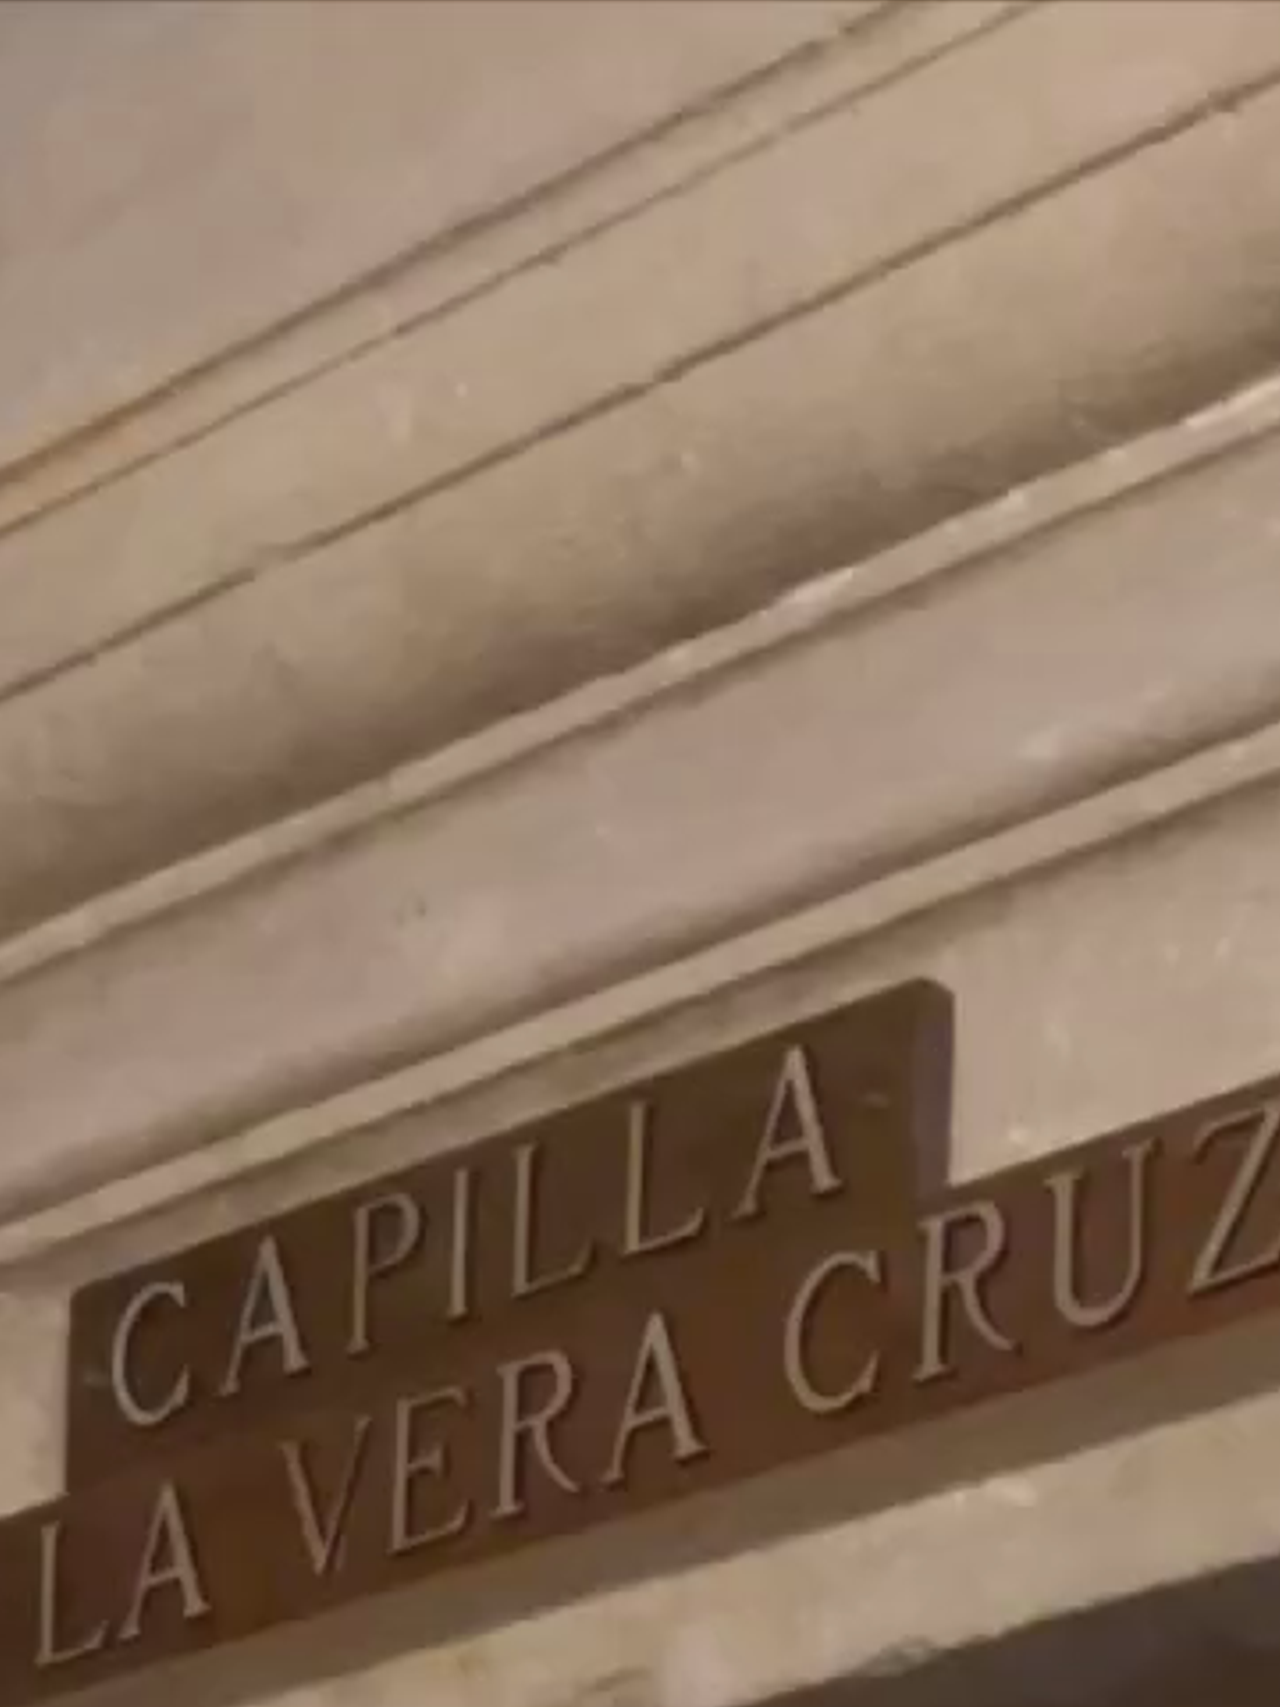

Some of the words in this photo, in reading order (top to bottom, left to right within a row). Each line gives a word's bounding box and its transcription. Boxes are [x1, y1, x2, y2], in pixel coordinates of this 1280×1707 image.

[108, 1042, 846, 1428] CAPILLA
[34, 1480, 212, 1668] LA
[280, 1310, 713, 1578] VERA
